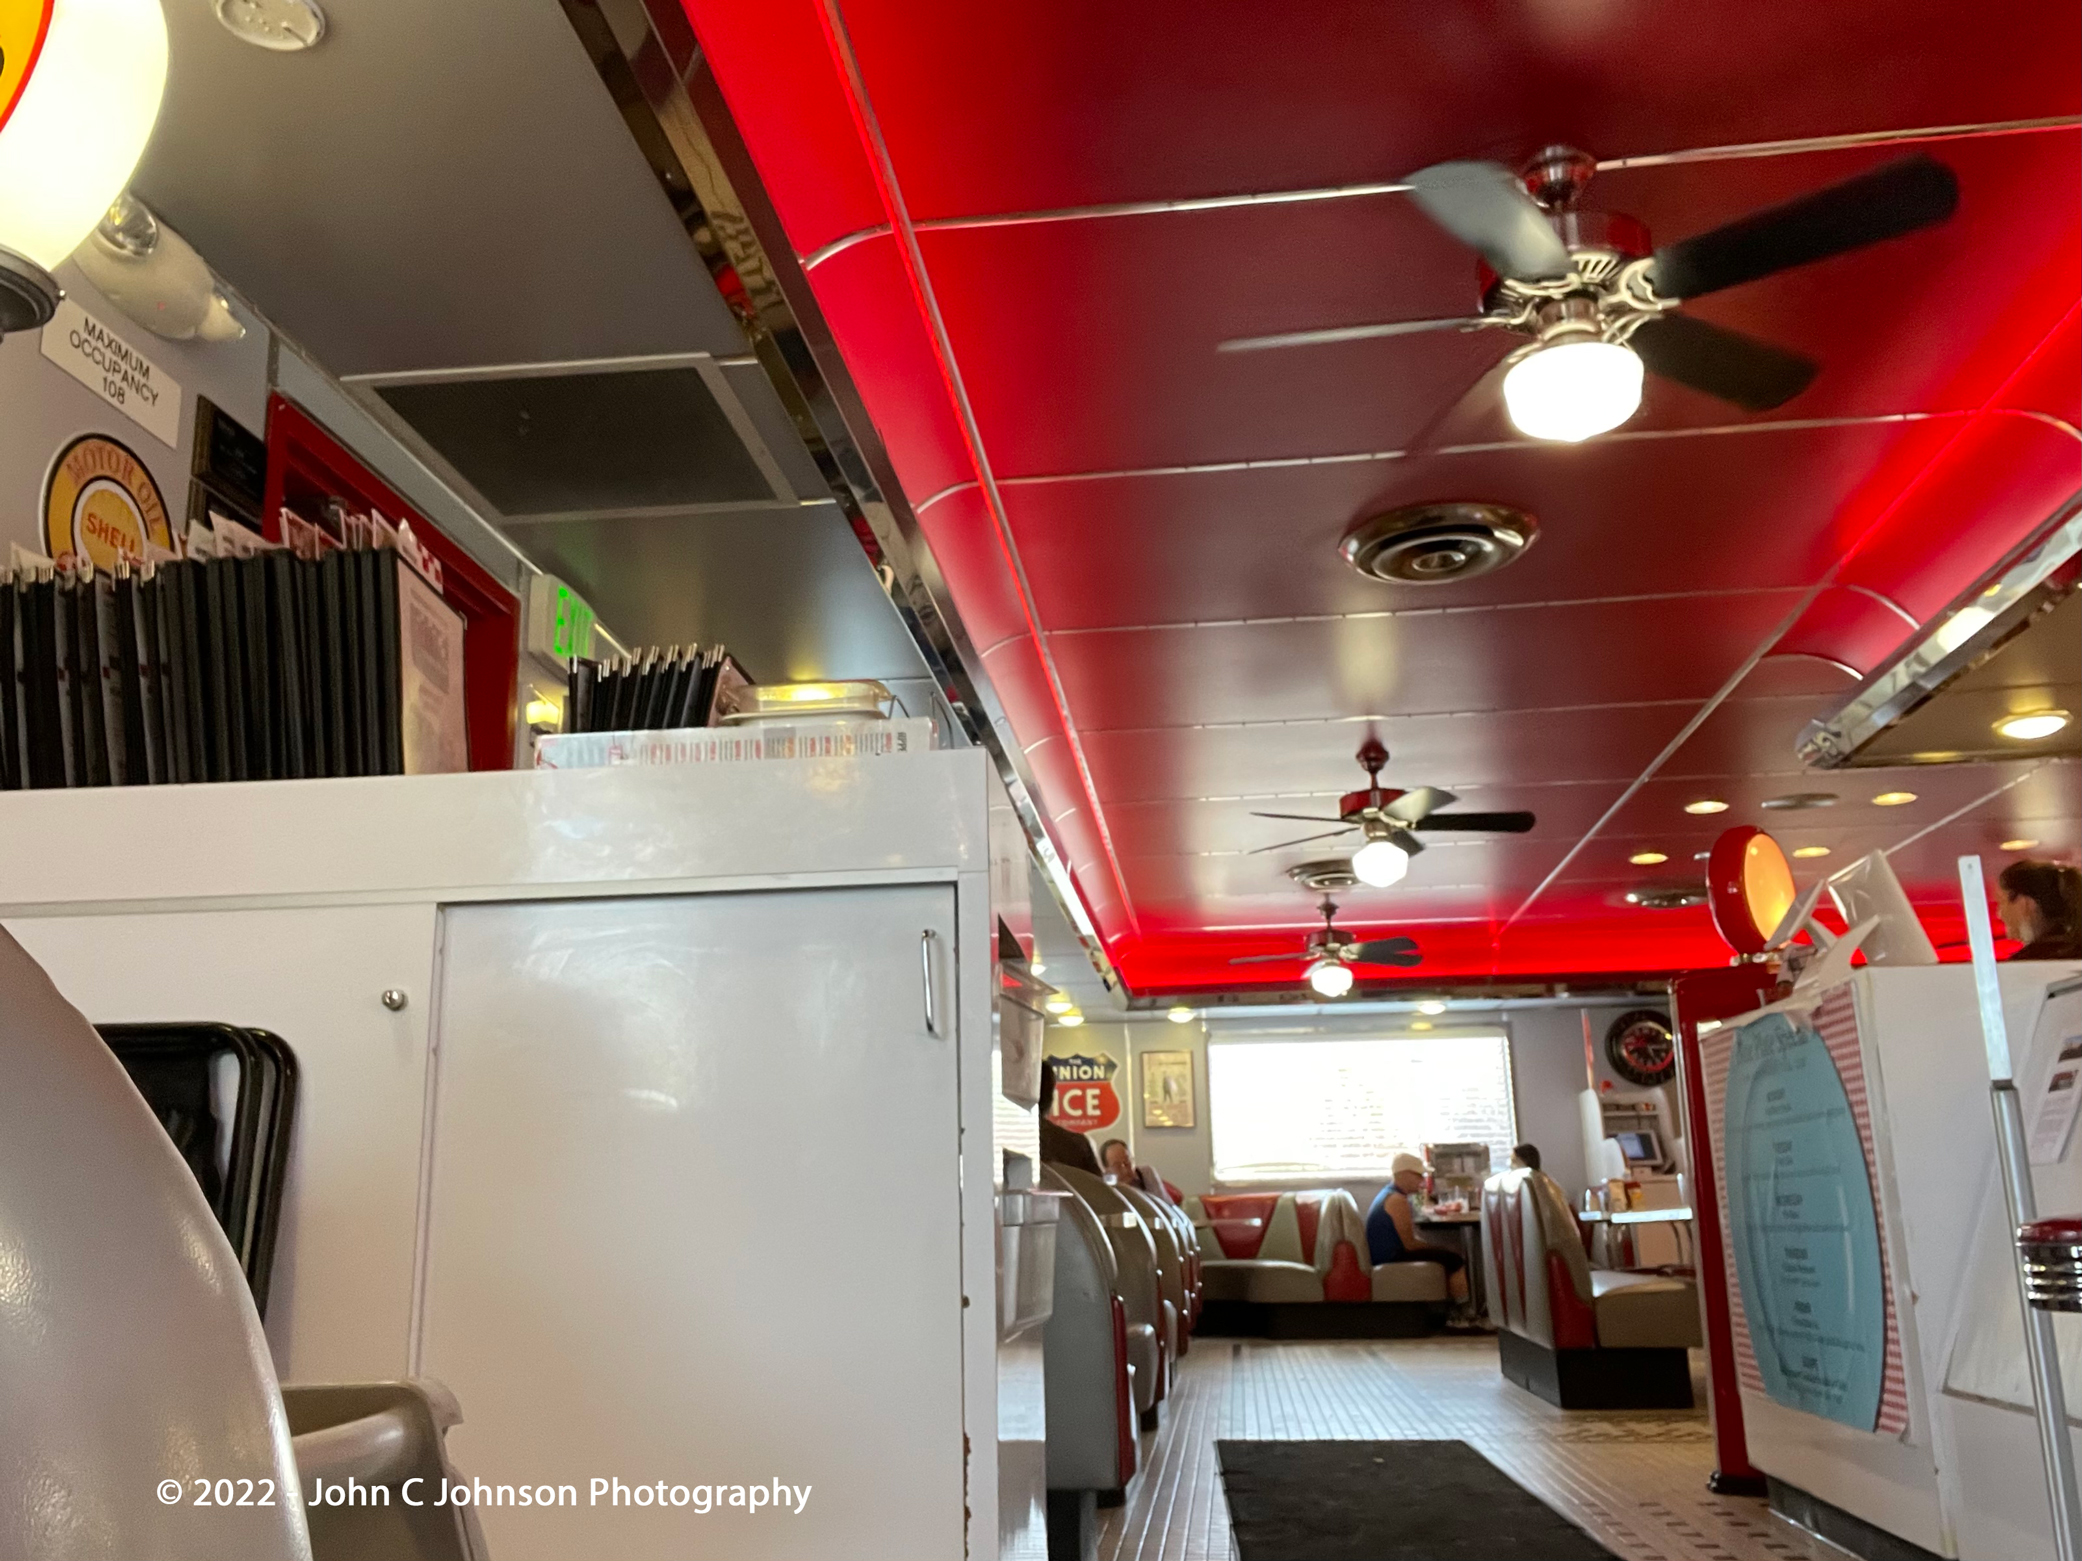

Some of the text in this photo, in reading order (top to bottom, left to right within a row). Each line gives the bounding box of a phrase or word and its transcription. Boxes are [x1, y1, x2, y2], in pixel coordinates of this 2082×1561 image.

[69, 329, 159, 407] OCCUPANCY
[83, 316, 150, 381] MAXIMUM
[102, 376, 126, 405] 108
[66, 443, 164, 532] MOTOR OIL
[86, 513, 136, 553] SHELL
[1052, 1088, 1101, 1117] ICE
